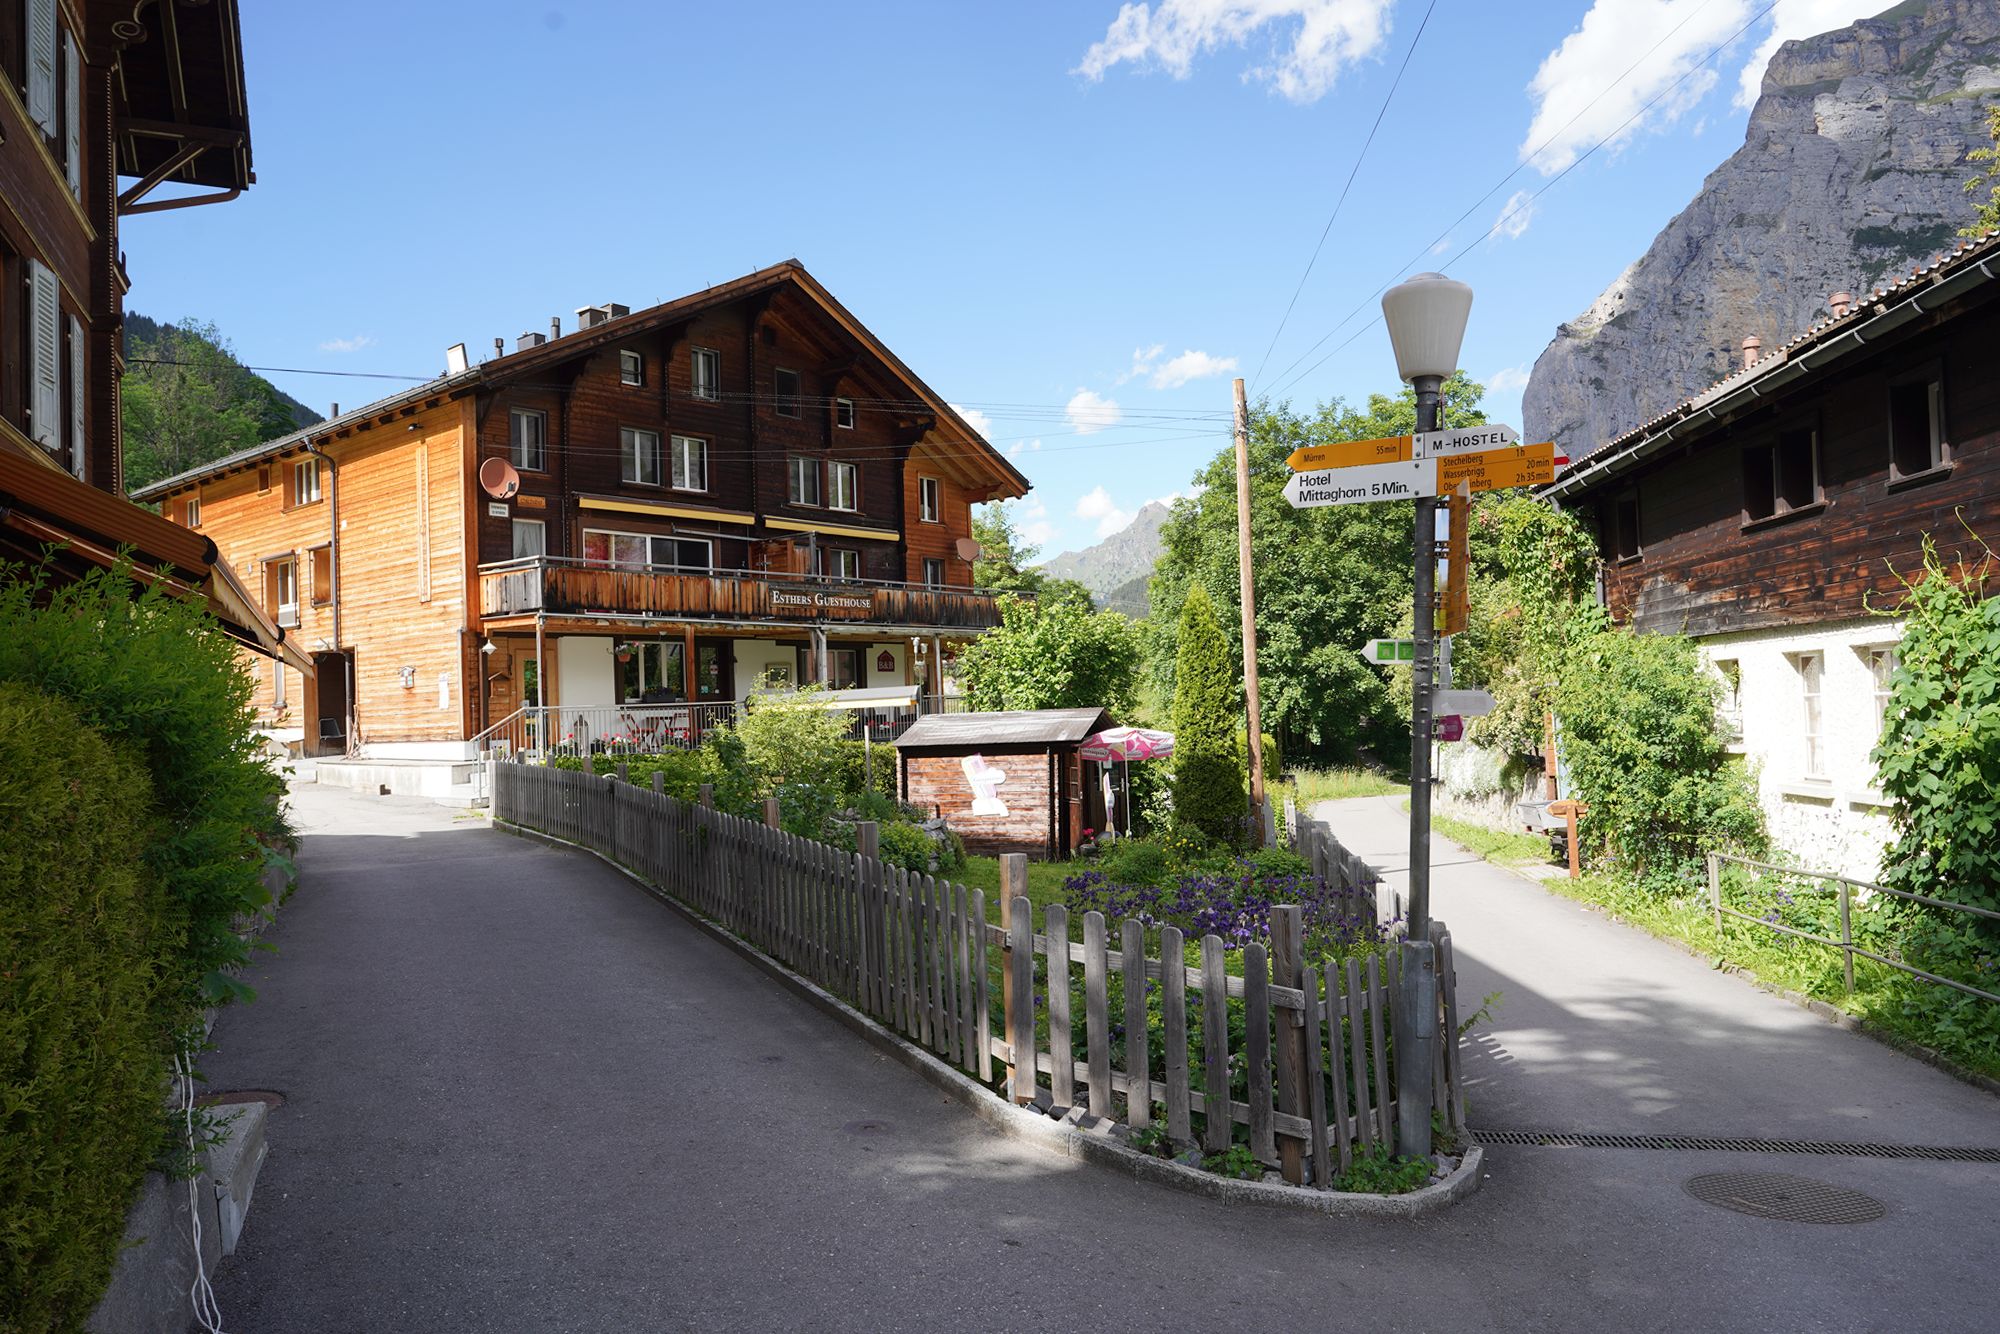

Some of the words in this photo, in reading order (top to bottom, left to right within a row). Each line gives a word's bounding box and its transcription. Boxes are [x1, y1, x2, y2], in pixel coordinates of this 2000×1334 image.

[1303, 453, 1326, 463] Mürren
[1443, 455, 1484, 467] Stechelberg
[1443, 467, 1485, 479] Wasserbrigg
[1299, 473, 1331, 487] Hotel
[1299, 488, 1366, 503] Mittaghorn
[1371, 483, 1380, 496] 5
[1382, 482, 1409, 495] Min.
[772, 590, 812, 605] ESTHERS
[814, 592, 871, 608] GUESTHOUSE
[878, 660, 894, 670] B&B
